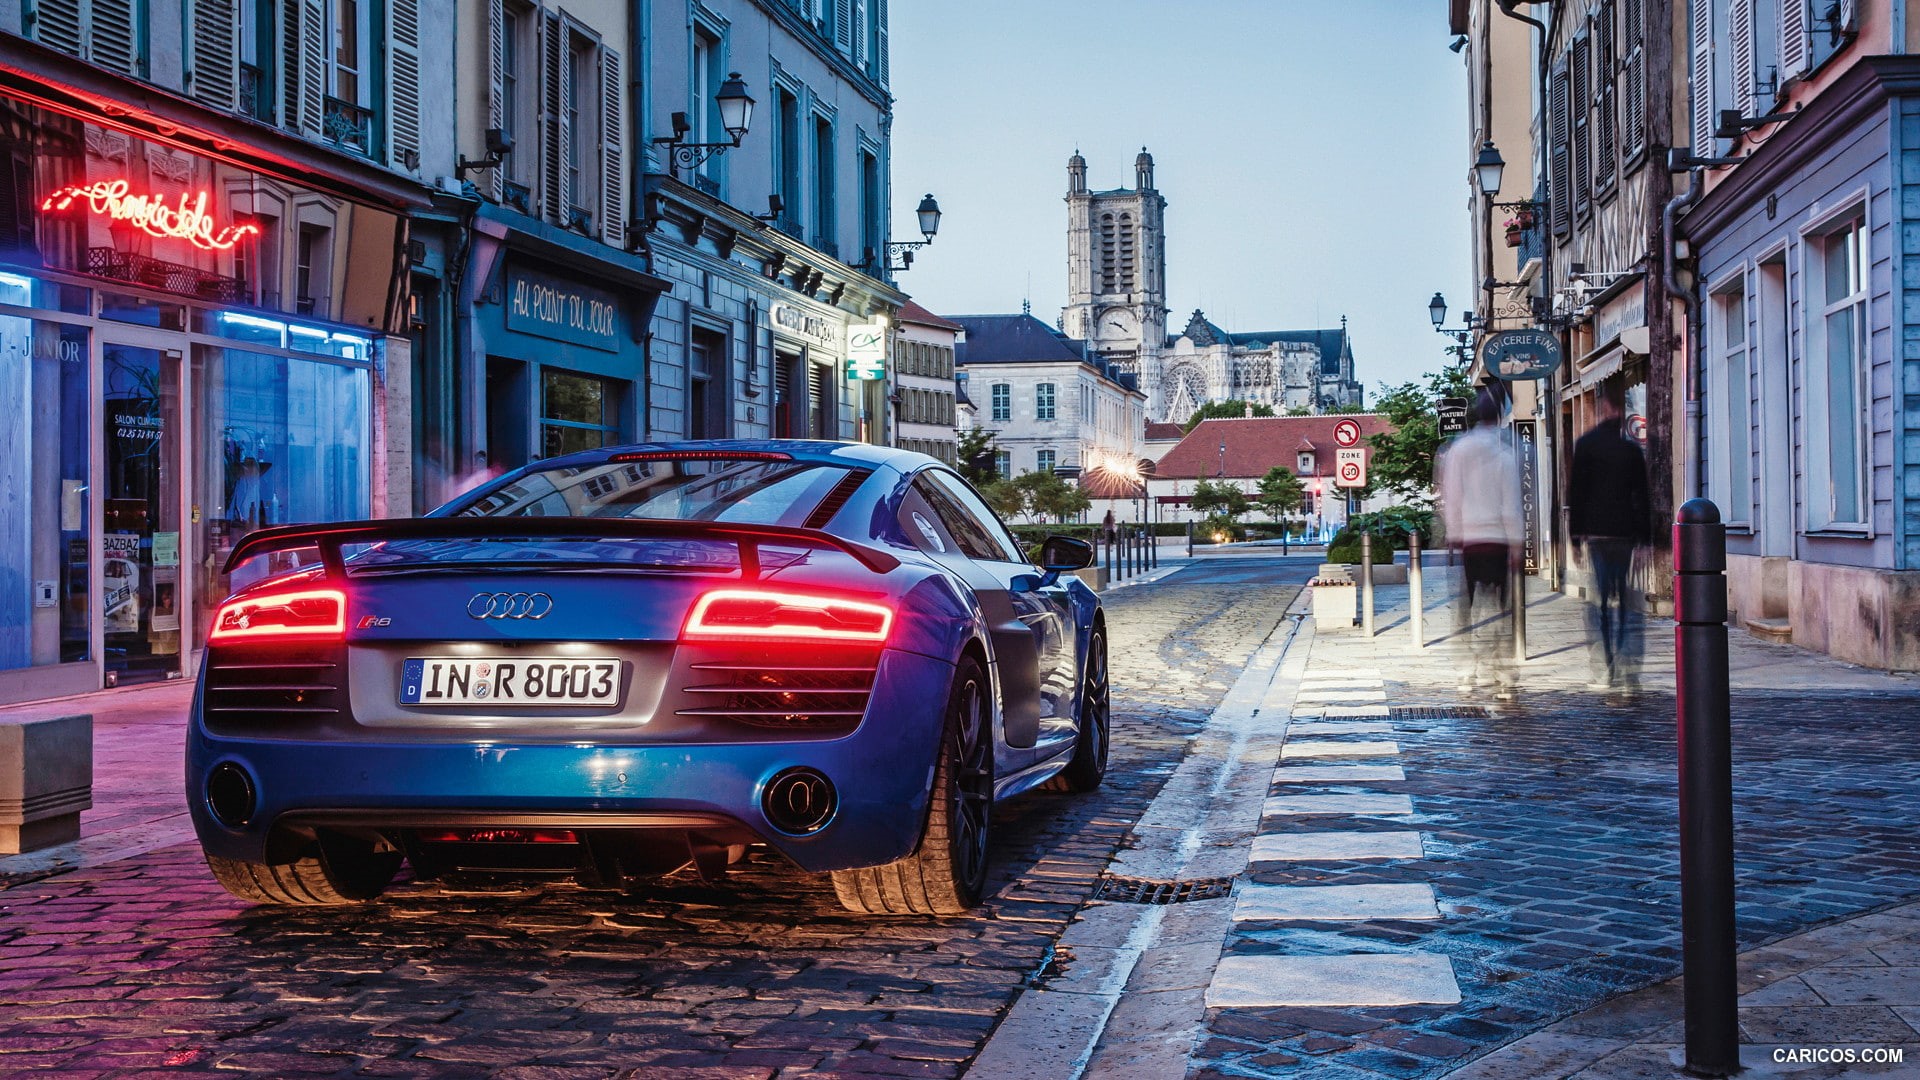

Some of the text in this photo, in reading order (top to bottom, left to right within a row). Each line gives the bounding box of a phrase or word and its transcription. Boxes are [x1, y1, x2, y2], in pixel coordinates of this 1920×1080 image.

[513, 279, 614, 336] AU POINT DU JOUR
[22, 336, 80, 362] JUNIOR
[1535, 335, 1557, 354] FINE
[115, 414, 136, 425] SALON
[1345, 468, 1357, 476] 30
[1522, 425, 1534, 567] ARTISAN COIFFEUR
[363, 616, 391, 627] R8
[407, 685, 416, 695] D
[425, 664, 614, 698] IN R 8003
